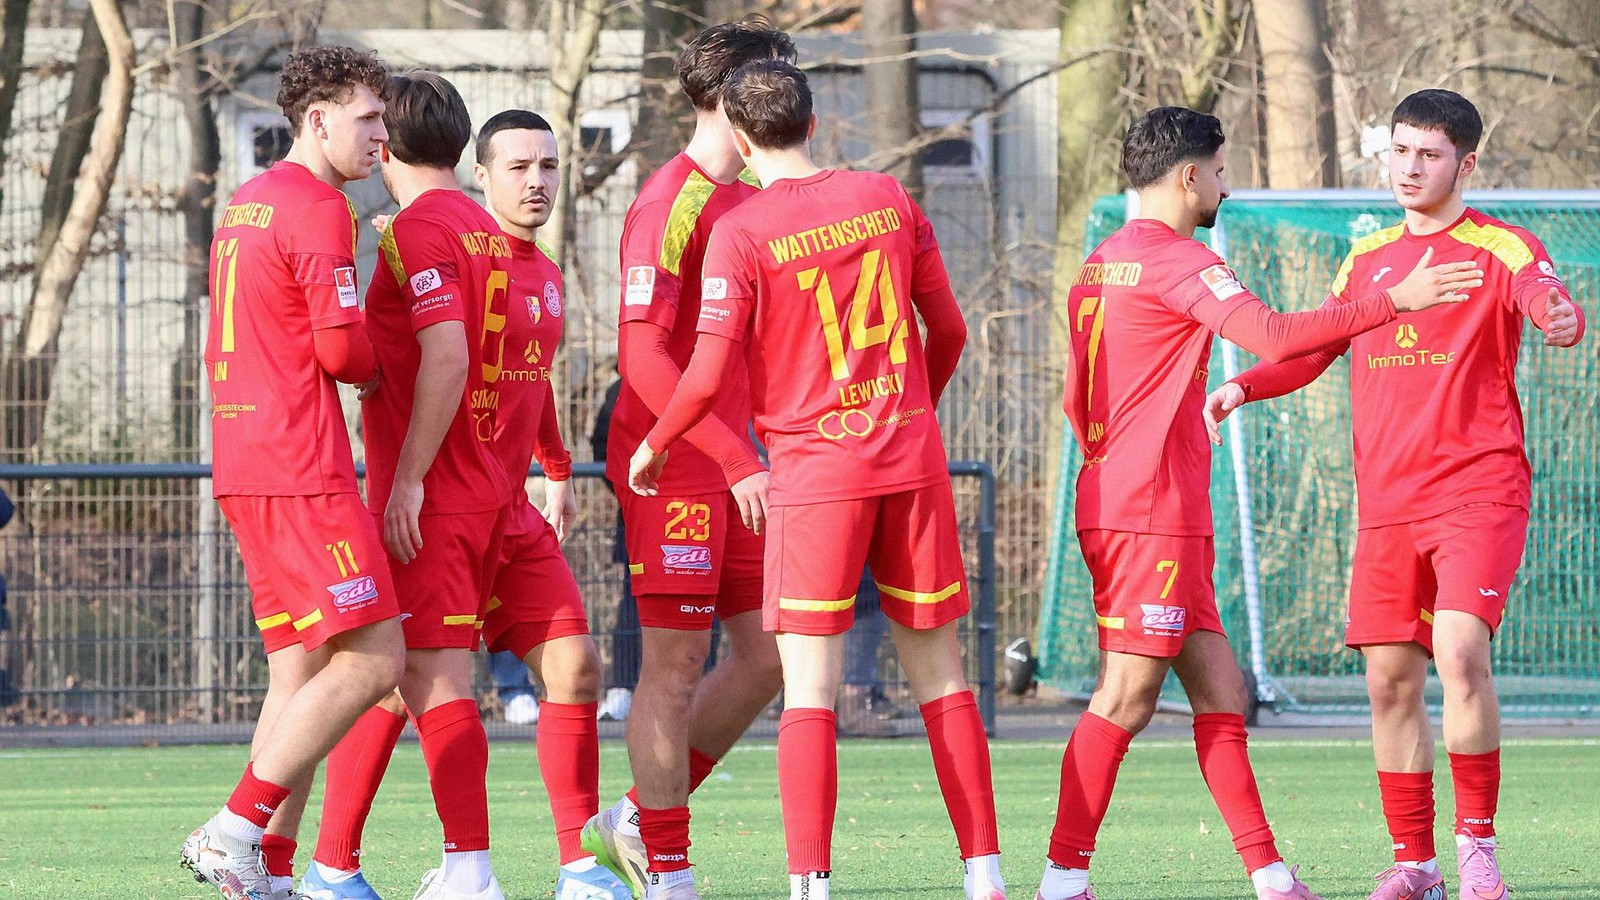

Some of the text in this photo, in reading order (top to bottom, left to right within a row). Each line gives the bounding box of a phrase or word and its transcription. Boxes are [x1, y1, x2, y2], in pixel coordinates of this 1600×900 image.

[768, 207, 901, 264] WATTENSCHEID
[796, 249, 909, 381] 14
[1077, 297, 1106, 411] 7
[839, 373, 903, 407] LEWICKI
[664, 501, 711, 541] 23
[325, 540, 360, 578] 11
[664, 549, 709, 565] edi
[334, 577, 375, 605] edi
[1156, 560, 1179, 599] 7
[1142, 609, 1185, 625] edi
